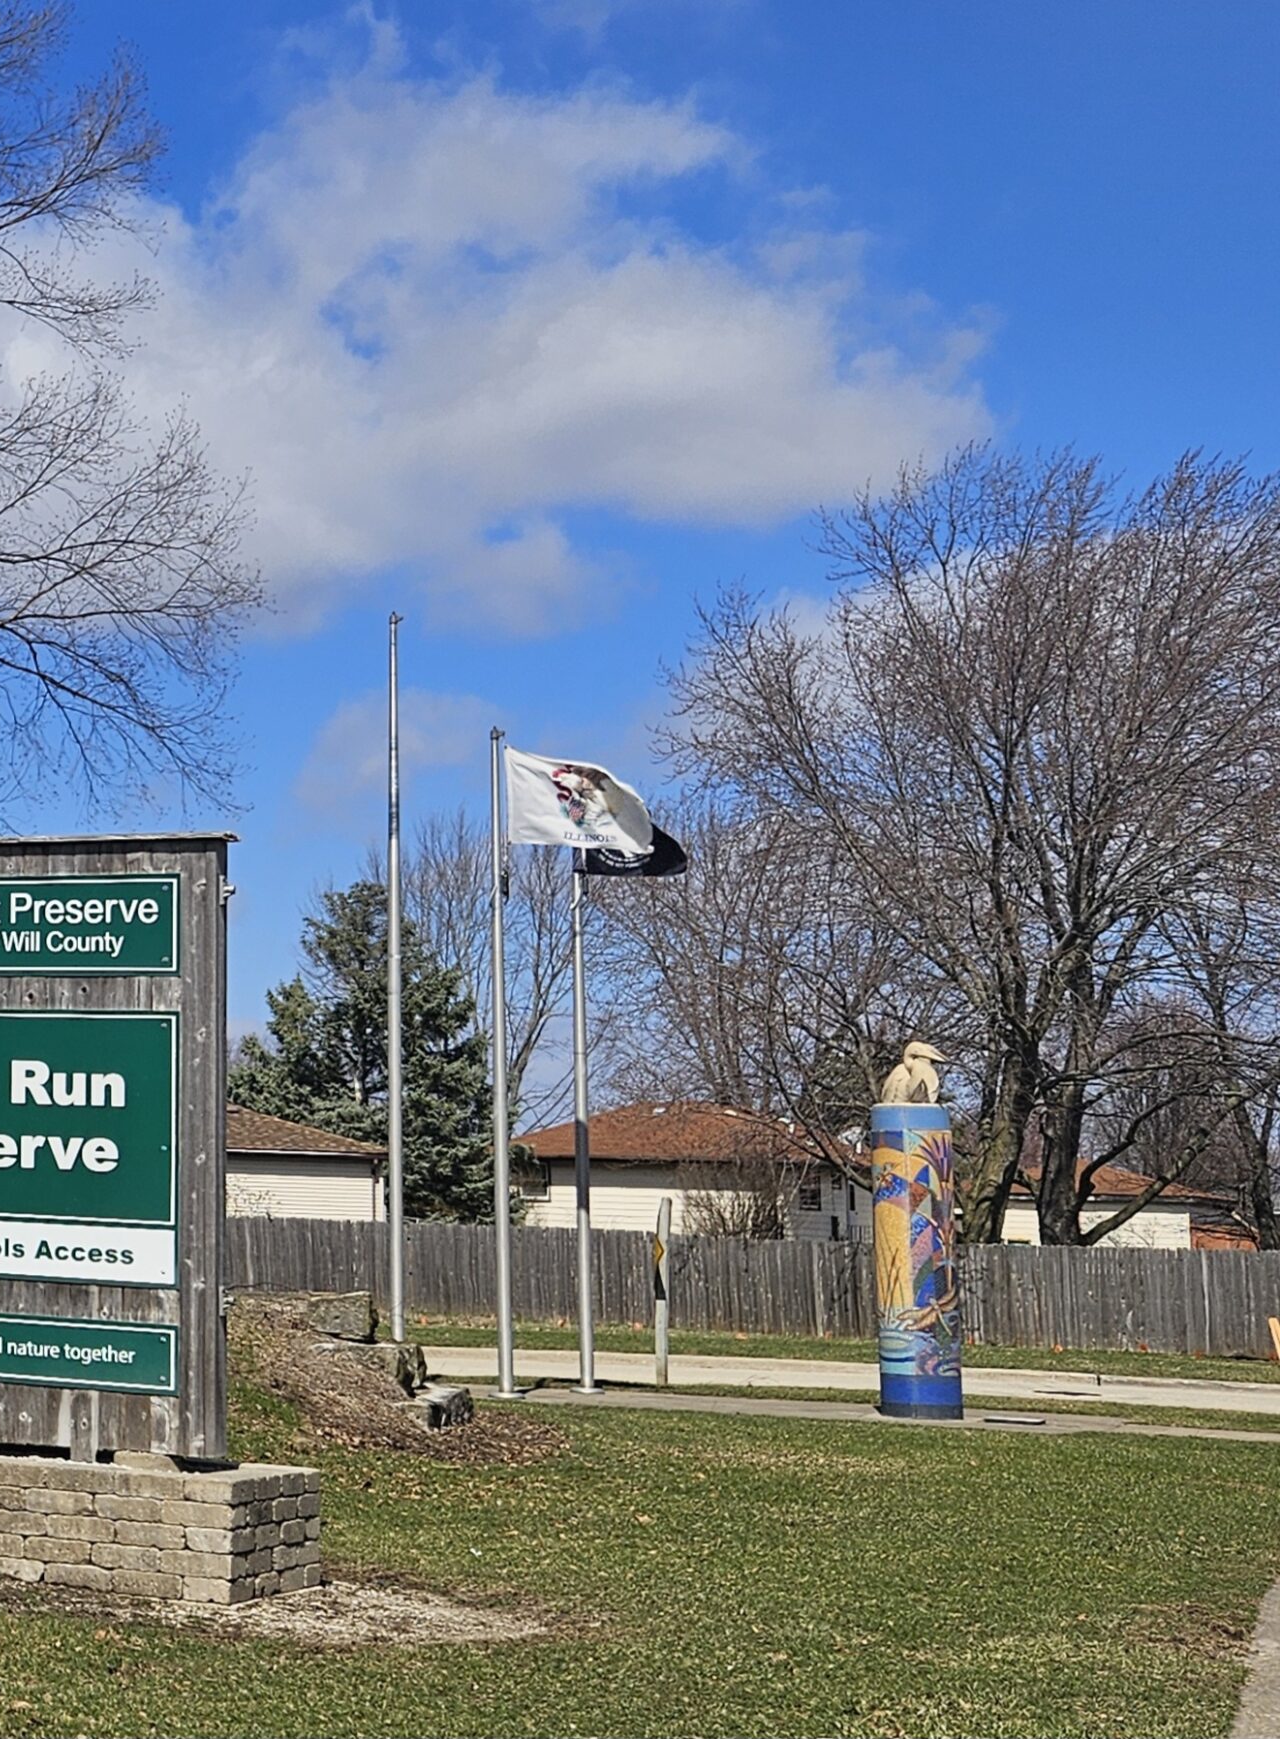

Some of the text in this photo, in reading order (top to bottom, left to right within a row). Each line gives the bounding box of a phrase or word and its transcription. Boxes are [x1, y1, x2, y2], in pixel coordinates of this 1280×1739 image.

[10, 893, 160, 925] Preserve
[2, 931, 40, 952] Will
[45, 931, 125, 957] County
[10, 1059, 126, 1108] Run
[34, 1240, 134, 1265] Access
[6, 1340, 60, 1359] nature
[63, 1342, 136, 1365] together
